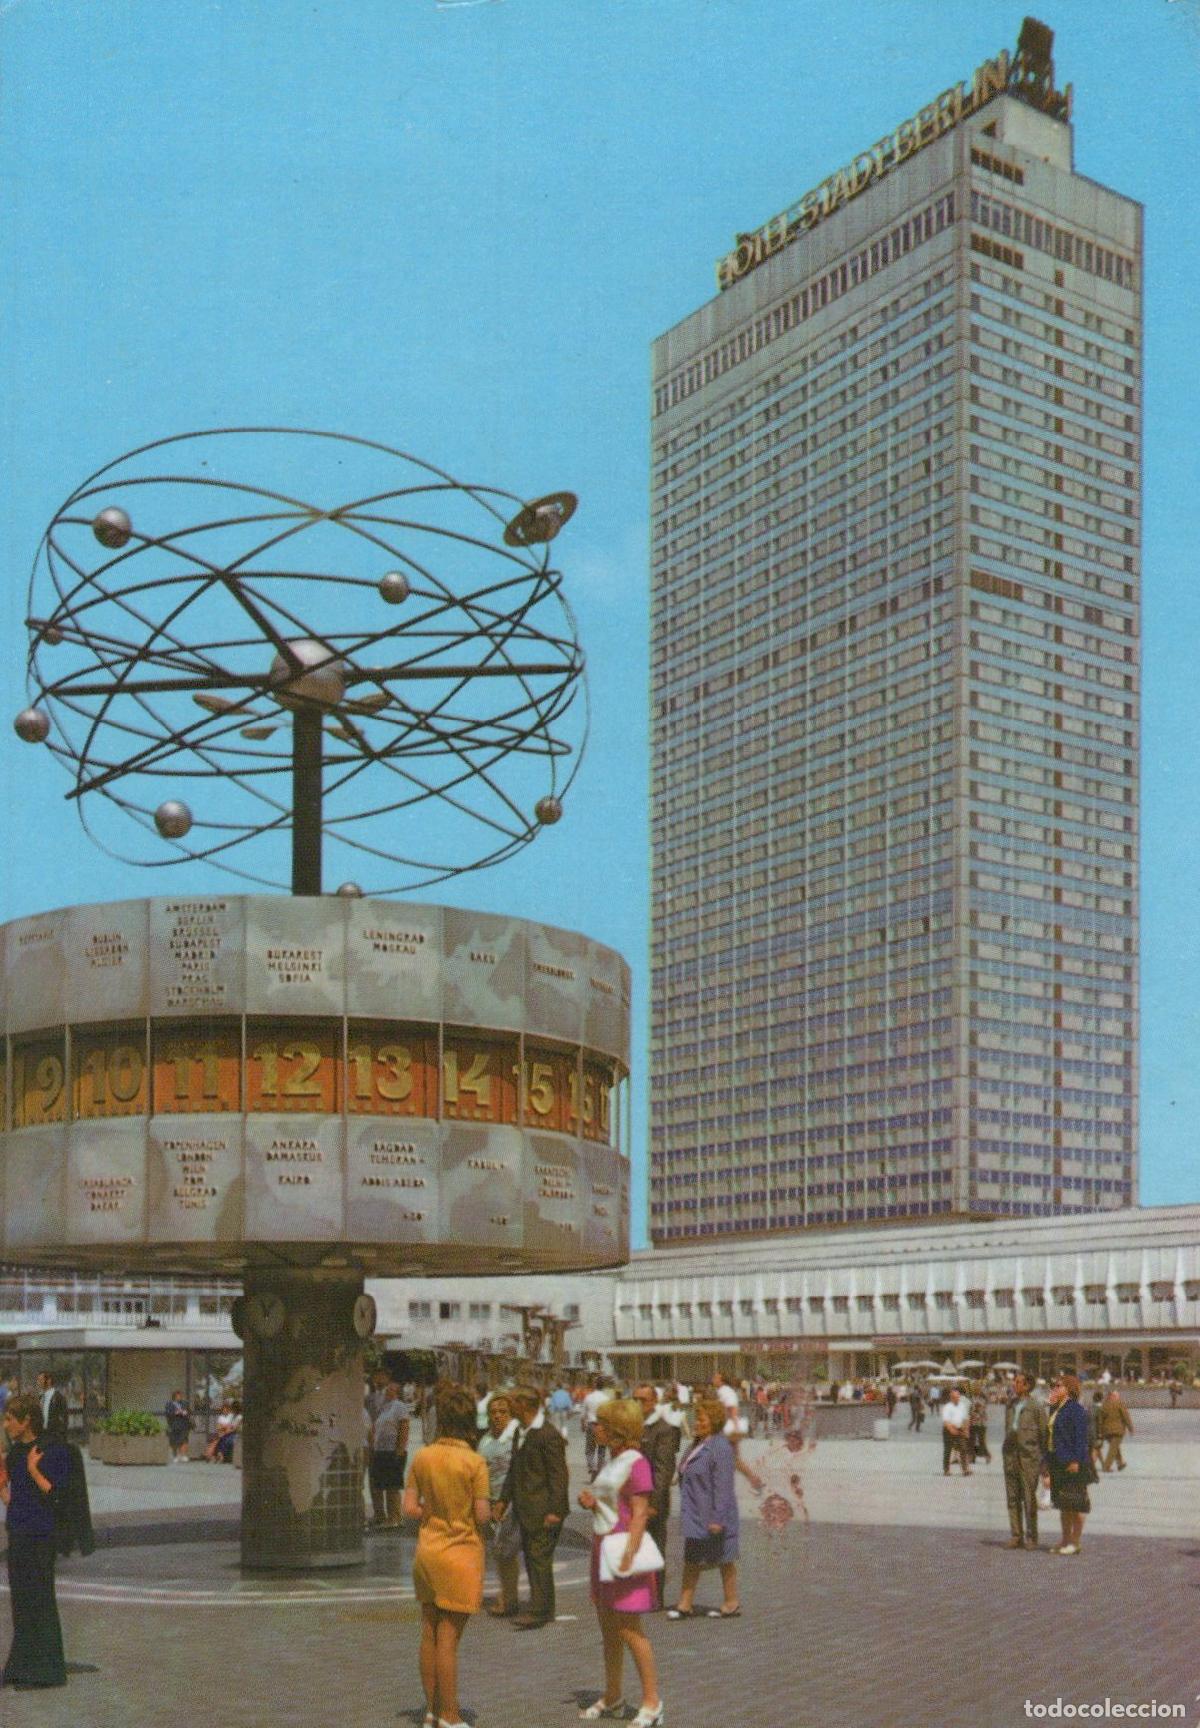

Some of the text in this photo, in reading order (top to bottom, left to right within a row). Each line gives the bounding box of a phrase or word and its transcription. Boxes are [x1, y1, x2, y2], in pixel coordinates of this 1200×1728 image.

[714, 211, 797, 292] HOTEL
[797, 138, 891, 230] STADT
[893, 48, 1009, 168] BERLIN
[165, 903, 226, 913] AMSTERDAM
[362, 929, 425, 945] LENINGRAD
[373, 942, 417, 955] MOSKAU
[266, 950, 322, 960] BUKAREST
[470, 952, 496, 965] BAKU
[268, 962, 322, 972] HELSINKI
[279, 973, 312, 984] SOFIA
[82, 1046, 145, 1105] 10
[166, 1042, 219, 1099] 11
[253, 1042, 322, 1097] 12
[348, 1044, 412, 1101] 13
[36, 1055, 63, 1113] 9
[442, 1049, 491, 1107] 14
[512, 1059, 555, 1115] 15
[163, 1140, 226, 1150] KOPENHAGEN
[271, 1140, 316, 1150] ANKARA
[374, 1143, 414, 1152] BAGDAD
[177, 1152, 212, 1162] LONDON
[266, 1152, 323, 1162] DAMASKUS
[370, 1154, 416, 1165] TEHERAN
[467, 1158, 497, 1170] KABUL
[278, 1175, 311, 1185] KAIRO
[361, 1176, 425, 1188] ADDIS ABEBA
[173, 1187, 217, 1198] BELGRAD
